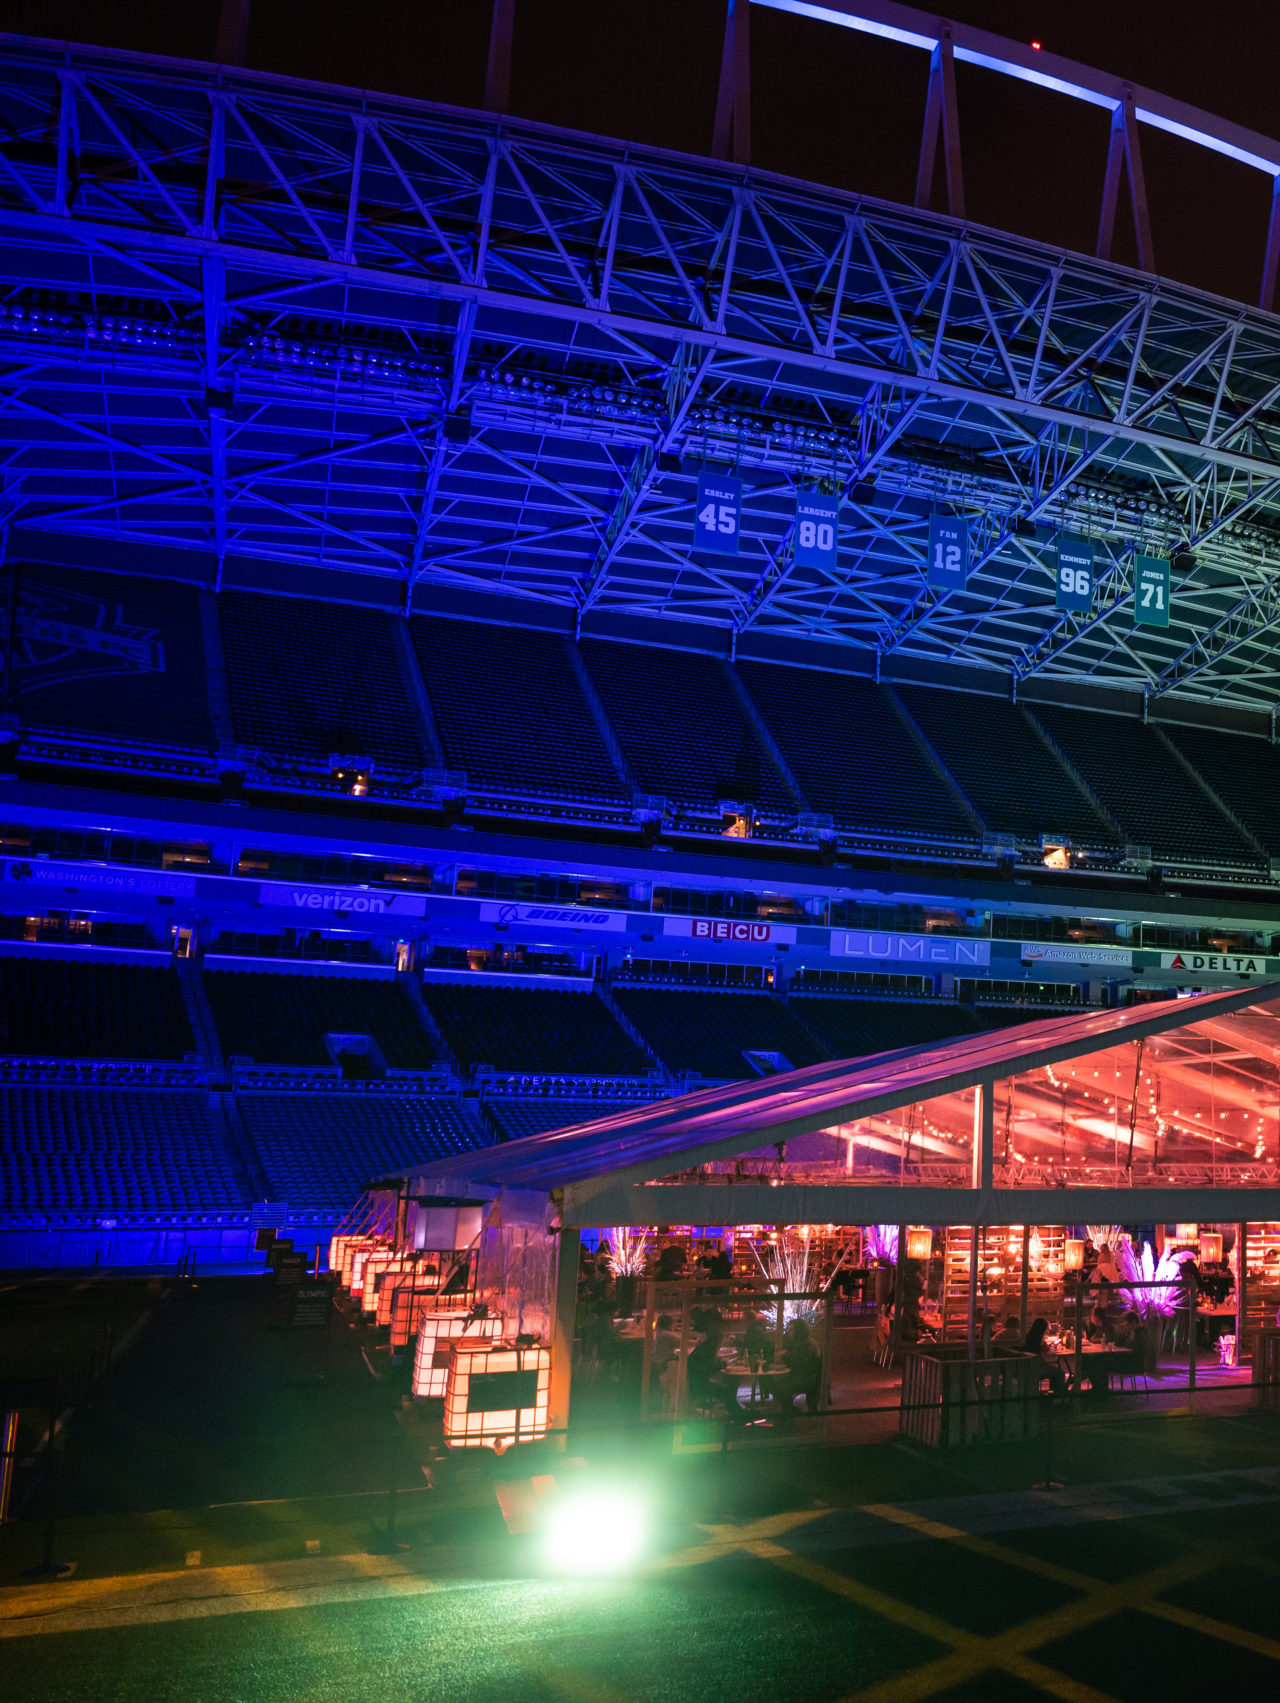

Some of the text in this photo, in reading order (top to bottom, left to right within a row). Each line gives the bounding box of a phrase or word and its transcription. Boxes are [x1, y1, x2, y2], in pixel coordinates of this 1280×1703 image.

[704, 488, 735, 500] EASLEY
[698, 503, 737, 534] 45
[798, 505, 837, 519] LARGENT
[799, 520, 834, 551] 80
[939, 529, 958, 540] FAN
[933, 542, 962, 572] 12
[1060, 554, 1091, 566] KENNEDY
[1060, 567, 1090, 595] 96
[1142, 570, 1165, 581] JONES
[1140, 582, 1165, 610] 71
[35, 869, 136, 887] WASHINGTON'S
[293, 891, 385, 913] verizon
[526, 909, 610, 924] BOEING
[696, 921, 769, 941] BECU
[844, 934, 979, 962] LUMEN
[1047, 950, 1078, 959] Amazon
[1080, 951, 1097, 960] Web
[1100, 952, 1130, 962] Services
[1193, 955, 1257, 972] DELTA
[521, 1076, 566, 1086] DELTA
[298, 1289, 328, 1298] OLYMPIC
